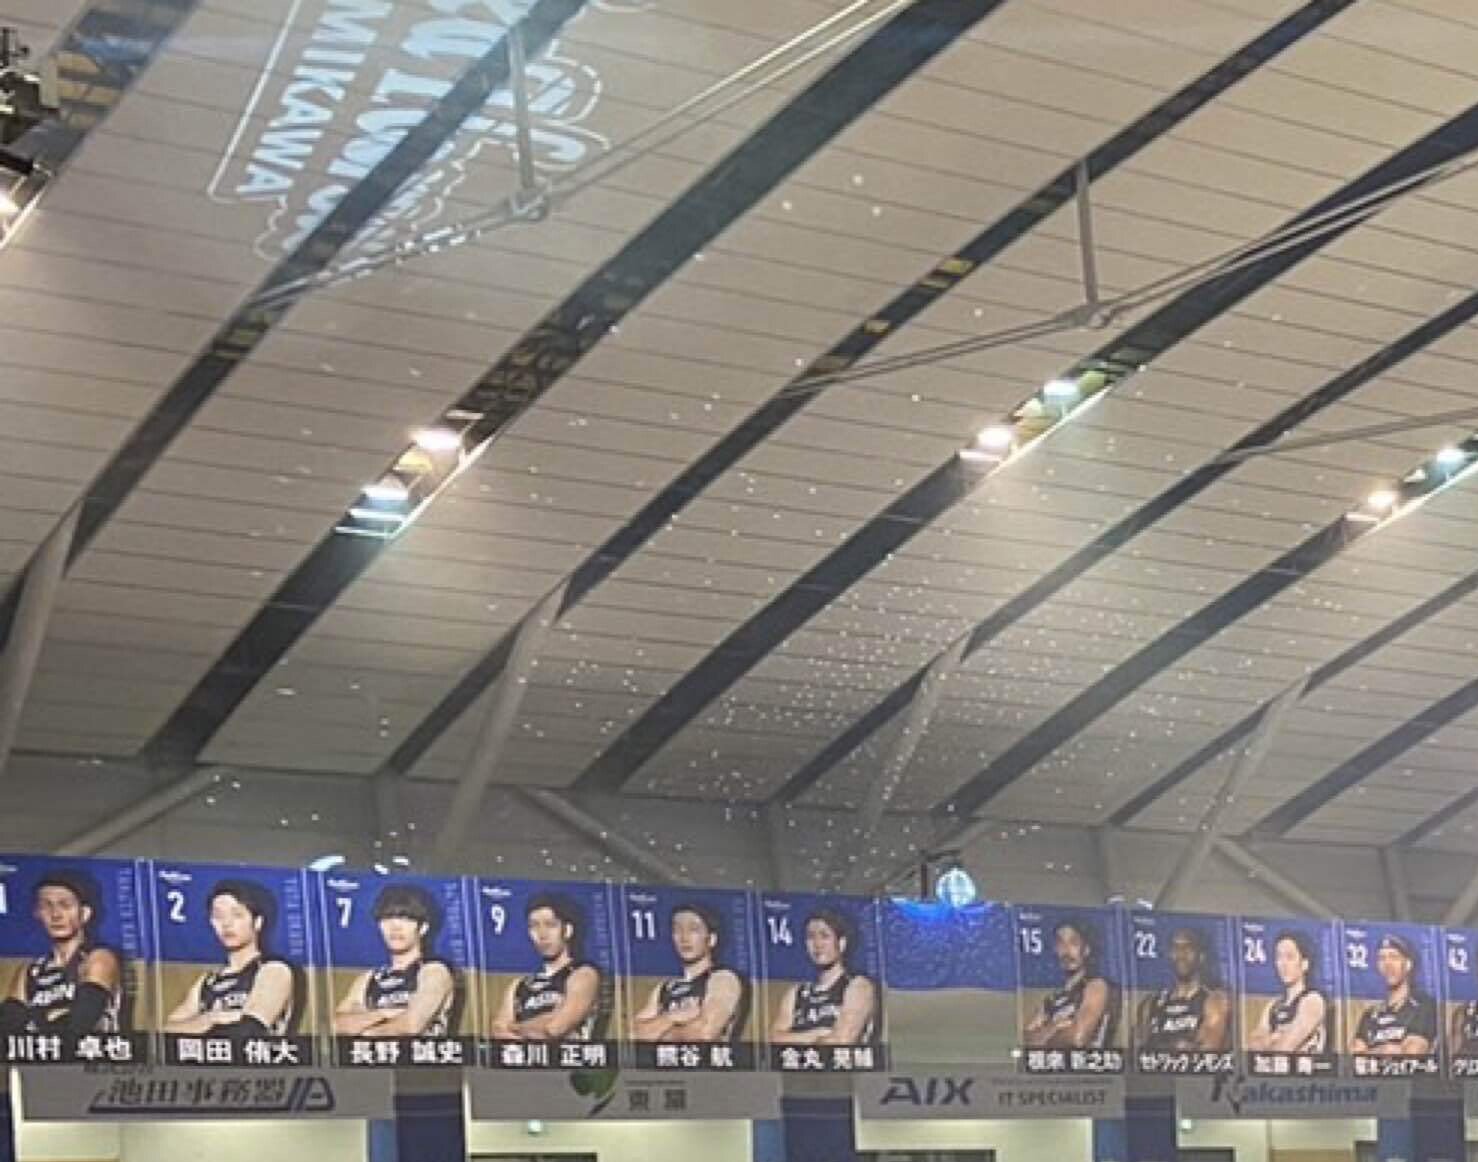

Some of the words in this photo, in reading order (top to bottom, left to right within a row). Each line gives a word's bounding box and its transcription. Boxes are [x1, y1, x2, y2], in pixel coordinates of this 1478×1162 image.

[167, 891, 187, 923] 2
[335, 898, 354, 929] 7
[490, 904, 506, 934] 9
[632, 910, 657, 940] 11
[767, 917, 793, 946] 14
[1019, 928, 1043, 955] 15
[1134, 932, 1158, 959] 22
[1244, 938, 1267, 965] 24
[1448, 948, 1469, 972] 42
[8, 1037, 61, 1061] 川村
[177, 1038, 233, 1062] 岡田
[349, 1041, 400, 1063] 長野
[560, 1045, 606, 1067] 正明
[880, 1078, 974, 1106] AIX
